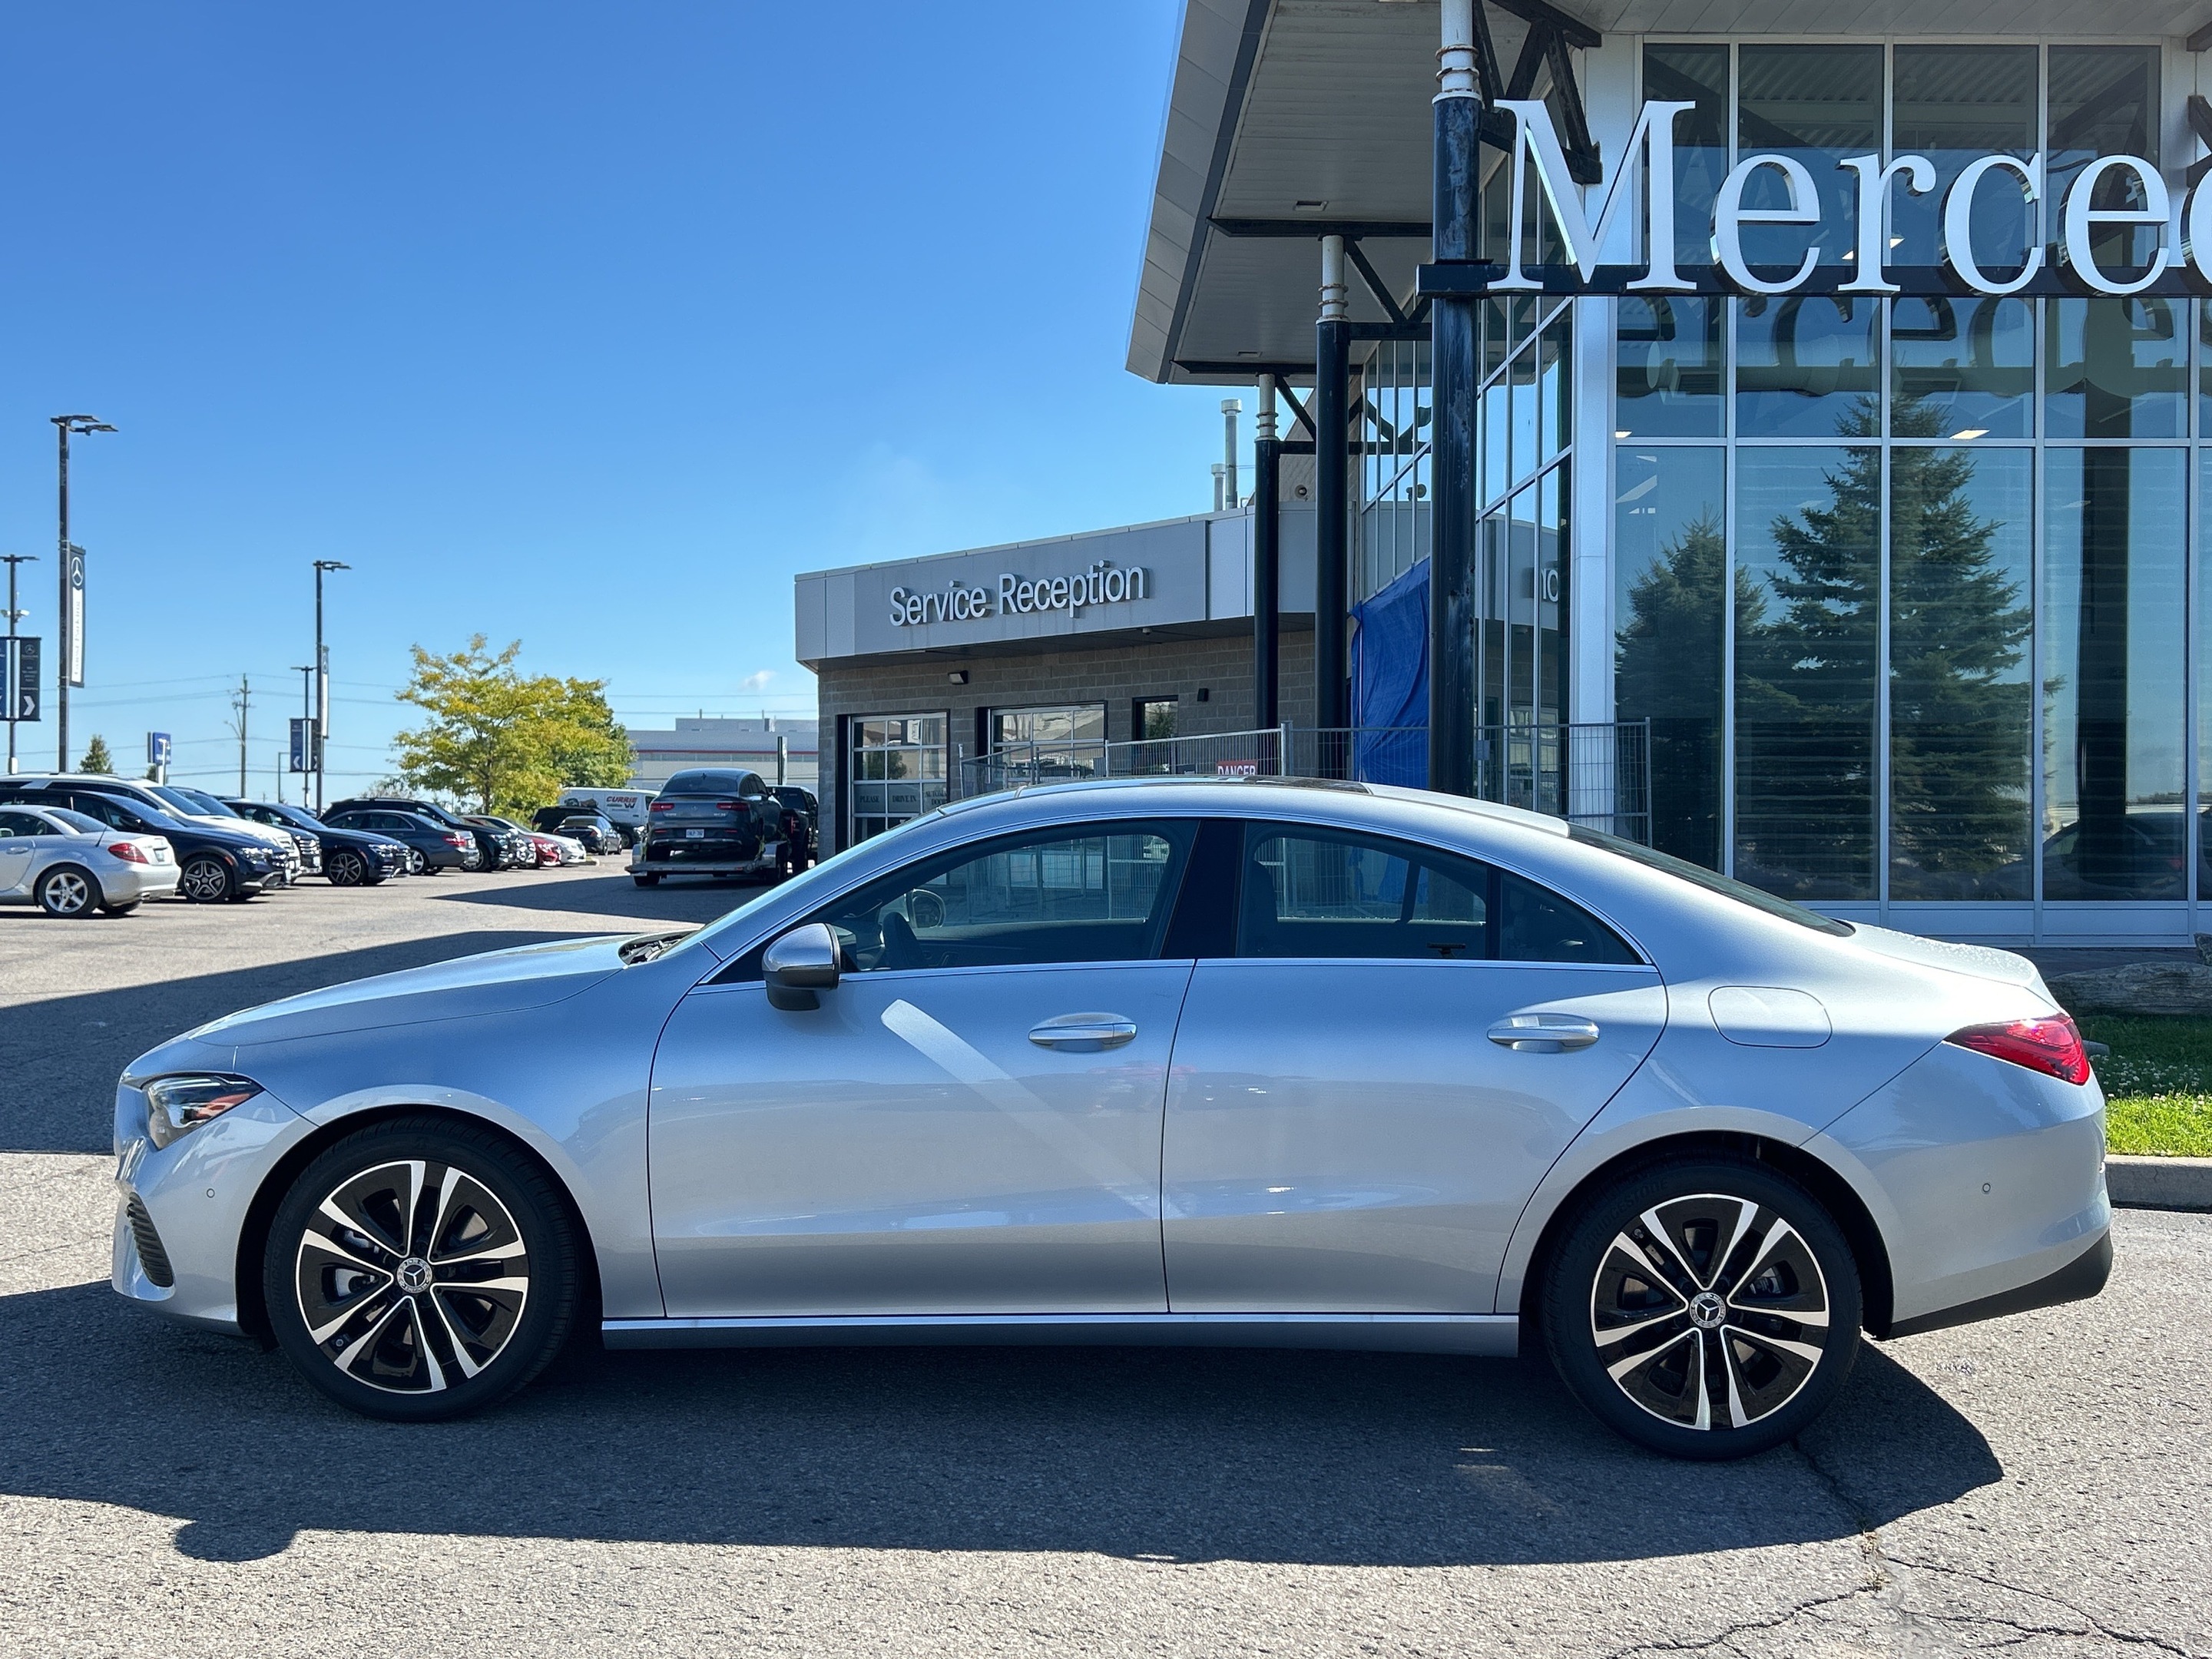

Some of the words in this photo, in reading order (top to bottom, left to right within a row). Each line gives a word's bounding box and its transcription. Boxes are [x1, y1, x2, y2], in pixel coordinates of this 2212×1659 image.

[1486, 98, 2212, 294] Merce
[889, 579, 991, 627] Service
[998, 560, 1149, 619] Reception
[859, 795, 879, 803] PLEASE
[892, 795, 909, 803] DRIVE
[909, 794, 917, 803] IN
